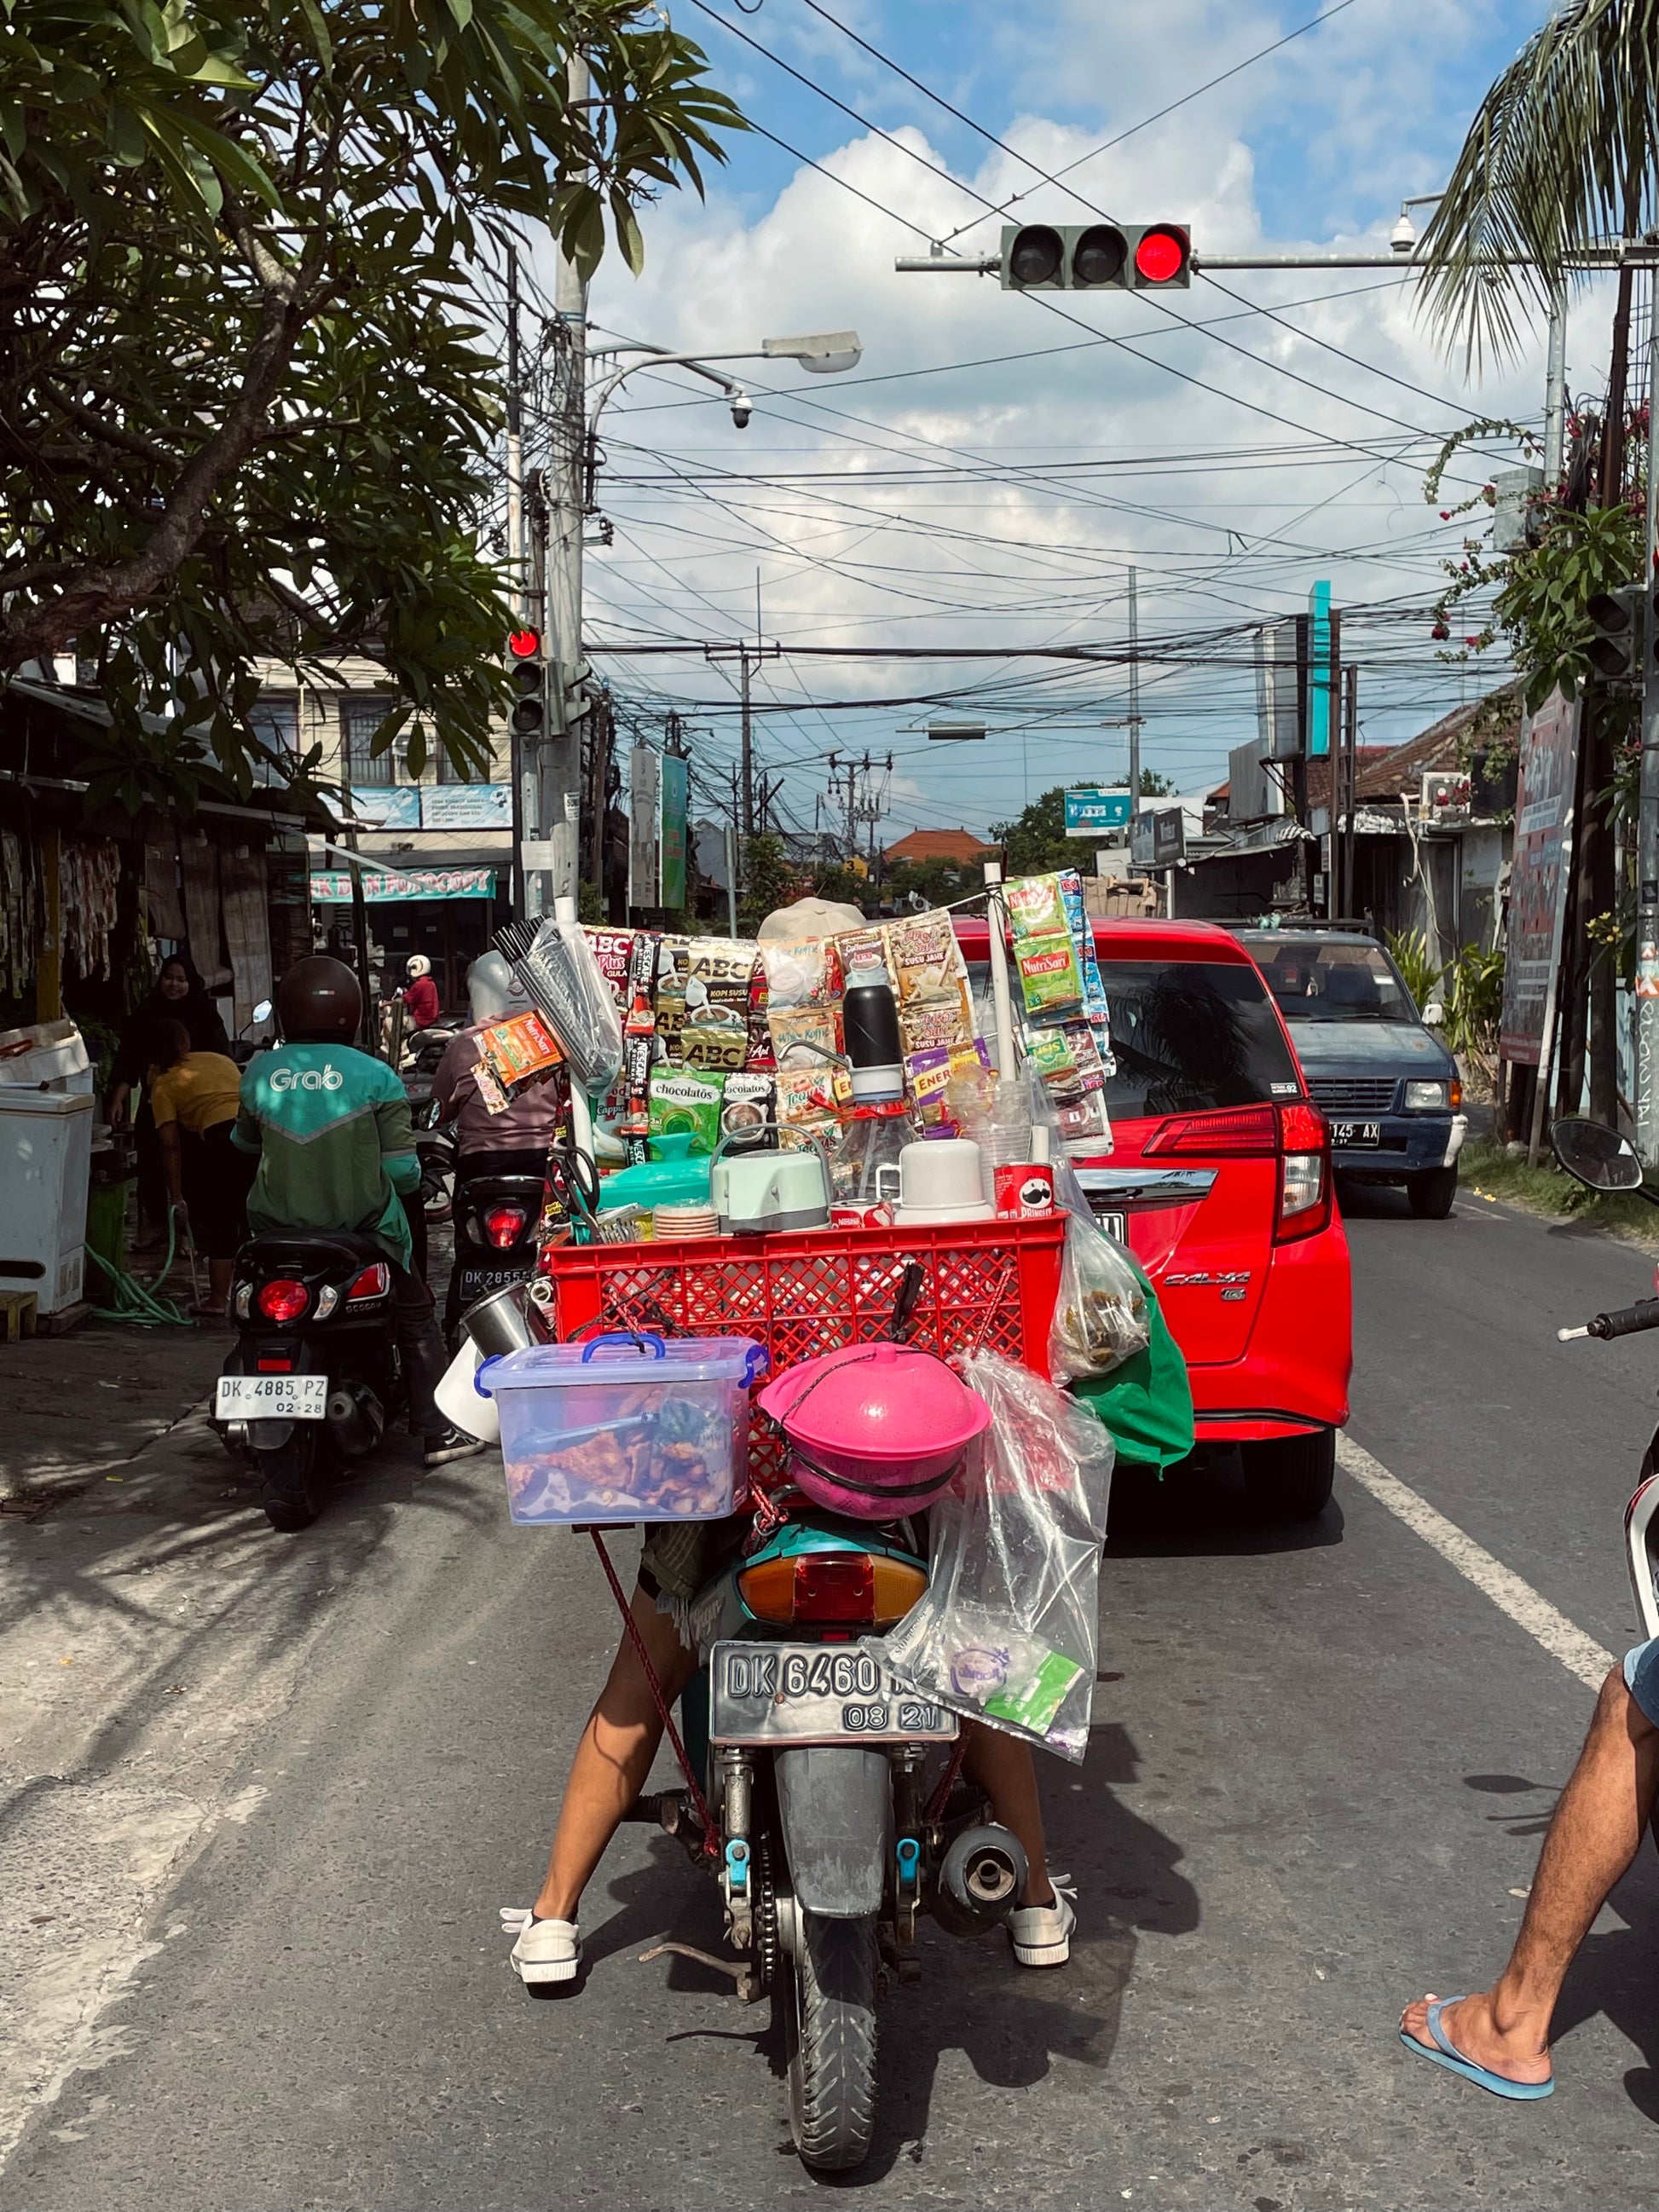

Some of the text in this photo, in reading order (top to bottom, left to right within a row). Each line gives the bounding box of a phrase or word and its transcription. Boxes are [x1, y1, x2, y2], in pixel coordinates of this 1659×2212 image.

[336, 875, 381, 895] DN
[598, 953, 625, 972] Plus
[691, 957, 749, 979] ABC
[904, 952, 945, 967] SUSU JAHE
[1022, 955, 1066, 975] NutriSari
[710, 989, 728, 997] KOPI
[915, 1039, 935, 1049] SUSU
[685, 1043, 742, 1066] ABC
[269, 1064, 344, 1092] Grab
[1362, 1123, 1378, 1139] AX
[465, 1271, 521, 1284] DK 2855
[222, 1380, 326, 1398] DK 4885 PZ
[728, 1653, 881, 1698] DK 6460
[842, 1703, 939, 1731] 08 21
